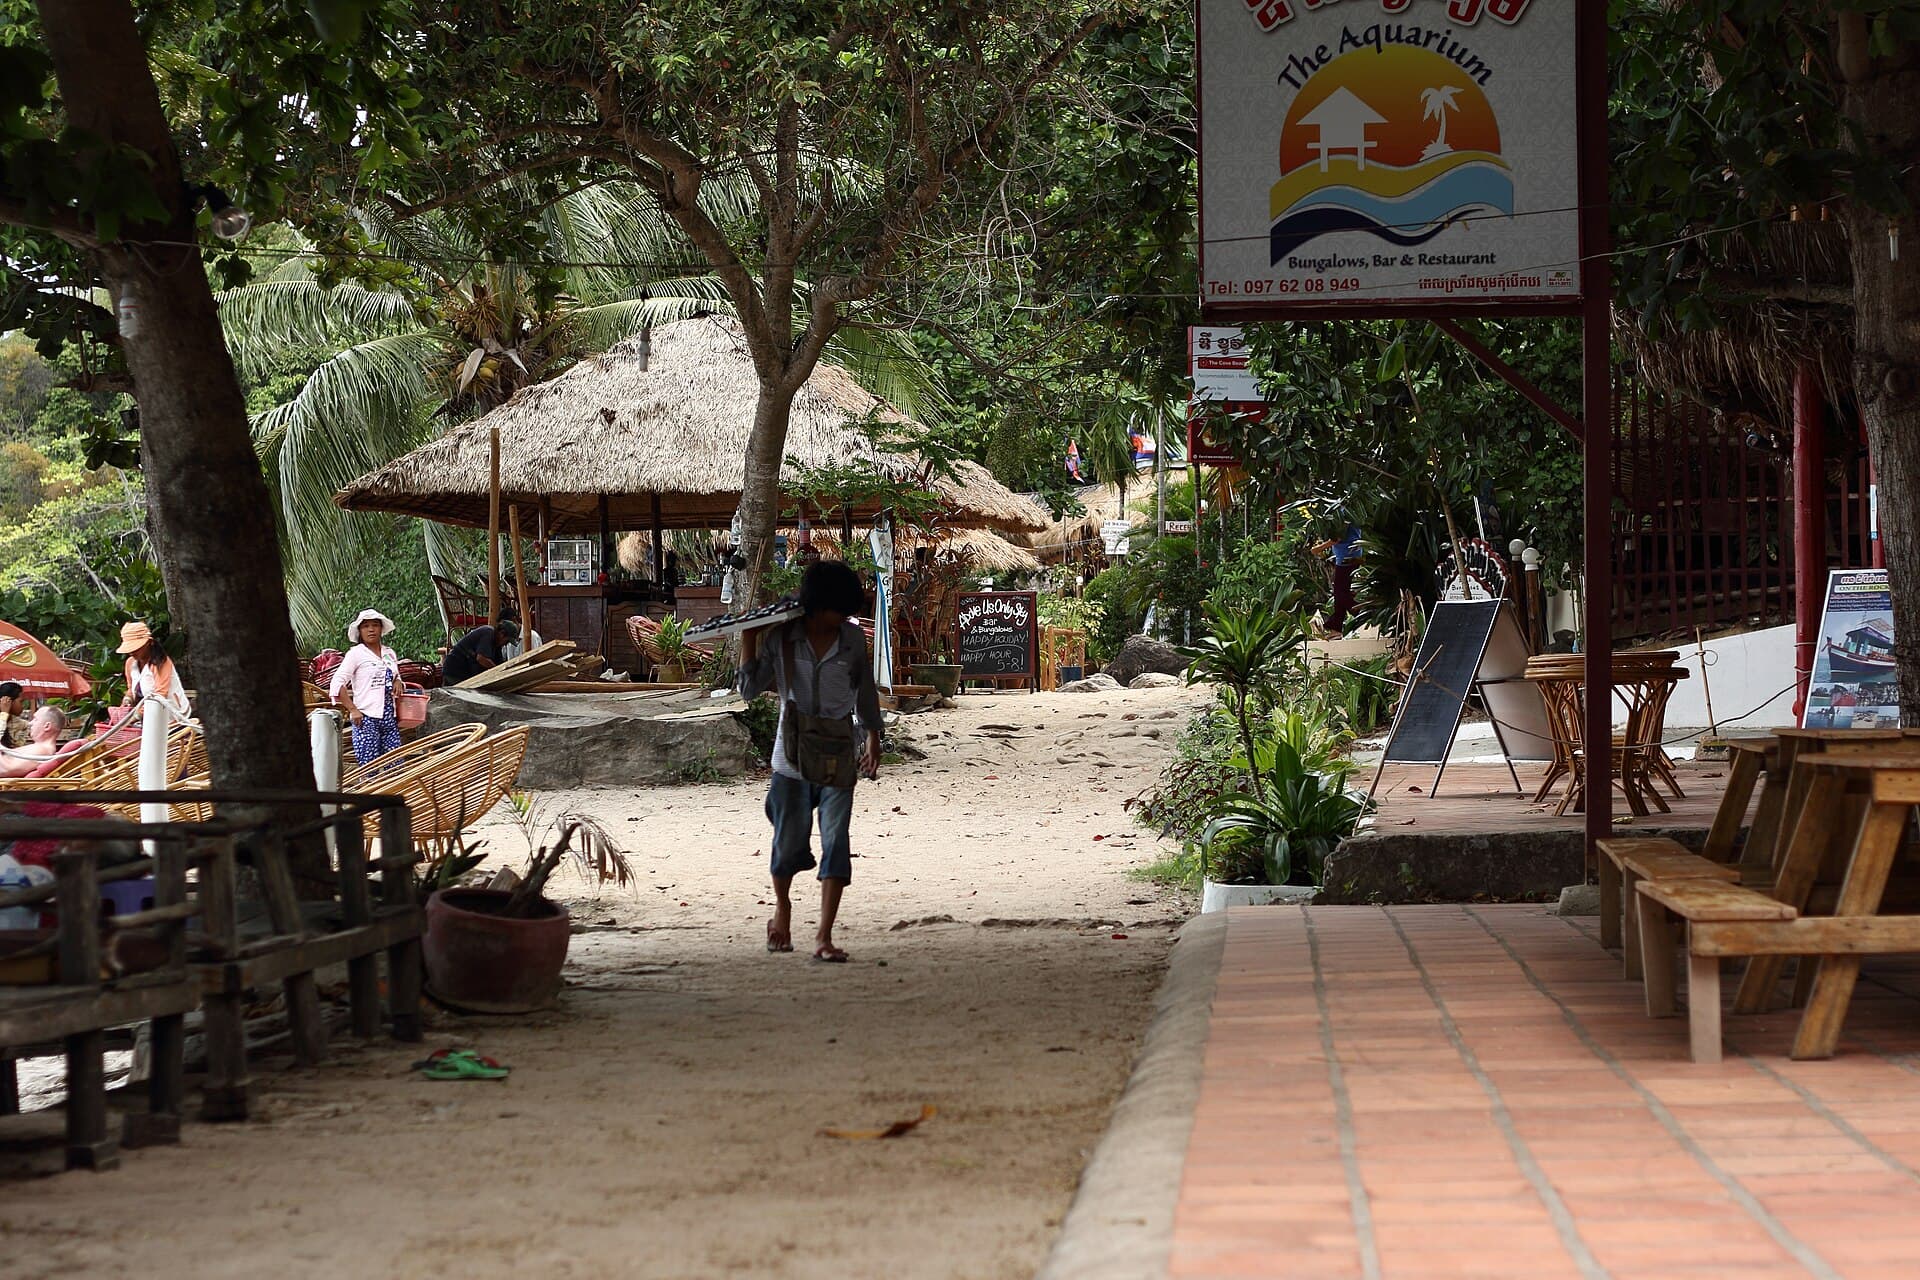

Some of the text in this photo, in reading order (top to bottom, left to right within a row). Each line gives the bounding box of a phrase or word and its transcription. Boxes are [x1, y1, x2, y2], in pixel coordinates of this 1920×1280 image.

[1277, 23, 1493, 90] The Aquarium
[1288, 252, 1496, 270] Bungalows, Bar & Restaurant
[1208, 277, 1360, 295] Tel: 097 62 08 949
[959, 606, 981, 629] Above
[983, 599, 994, 615] Us
[995, 598, 1014, 619] Only
[1013, 603, 1029, 626] Sky
[982, 618, 998, 626] Bar
[970, 625, 1013, 635] & Bungalows
[962, 635, 993, 647] HAPPY
[961, 649, 1011, 663] HAPPY HOUR
[997, 653, 1024, 672] 5-8!
